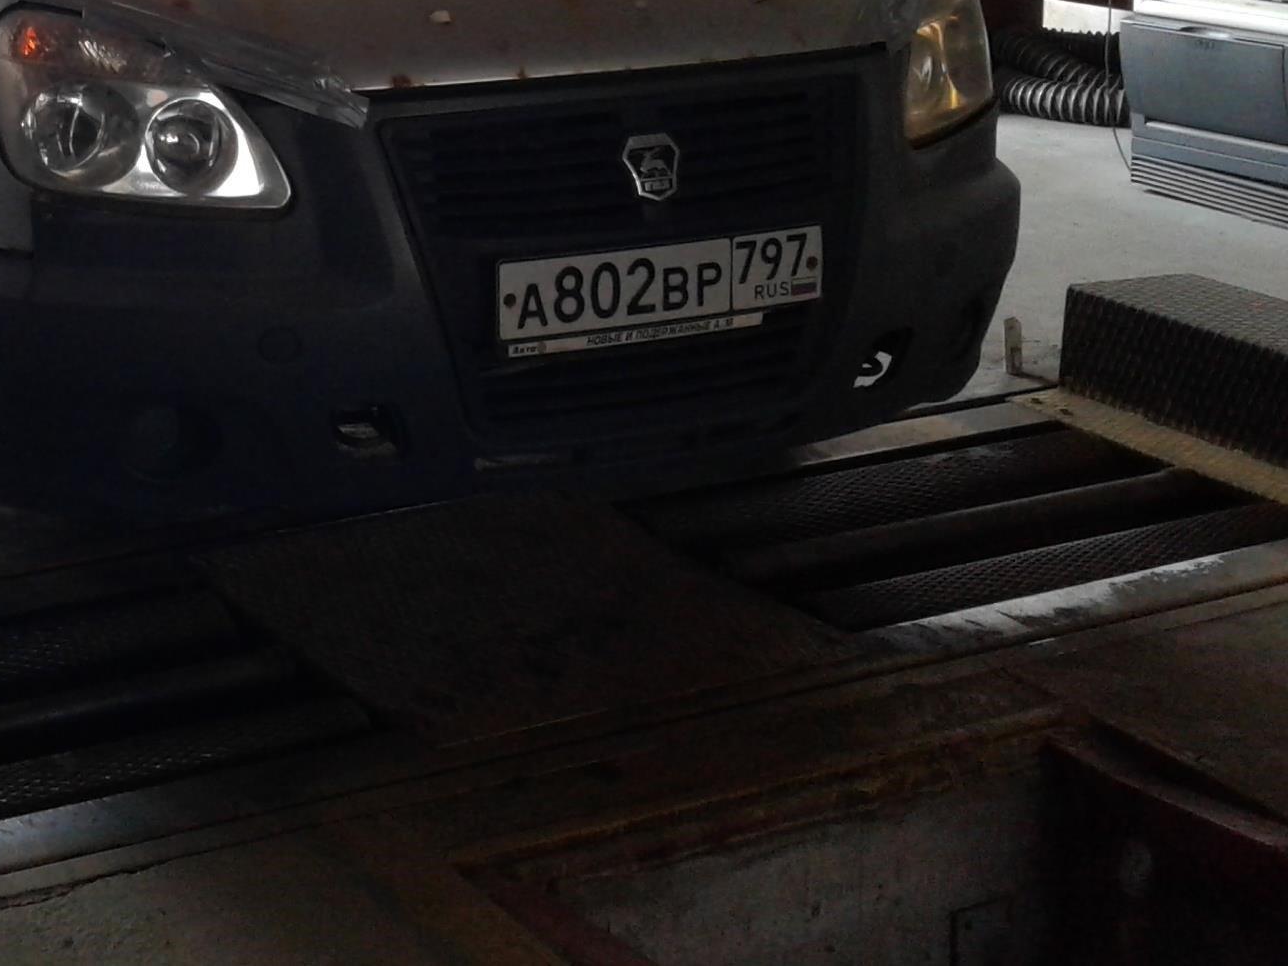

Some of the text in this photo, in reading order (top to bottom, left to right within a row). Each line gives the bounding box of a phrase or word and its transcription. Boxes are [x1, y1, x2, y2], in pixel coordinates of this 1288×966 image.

[517, 233, 808, 330] А802ВР 797
[754, 282, 790, 300] RUS
